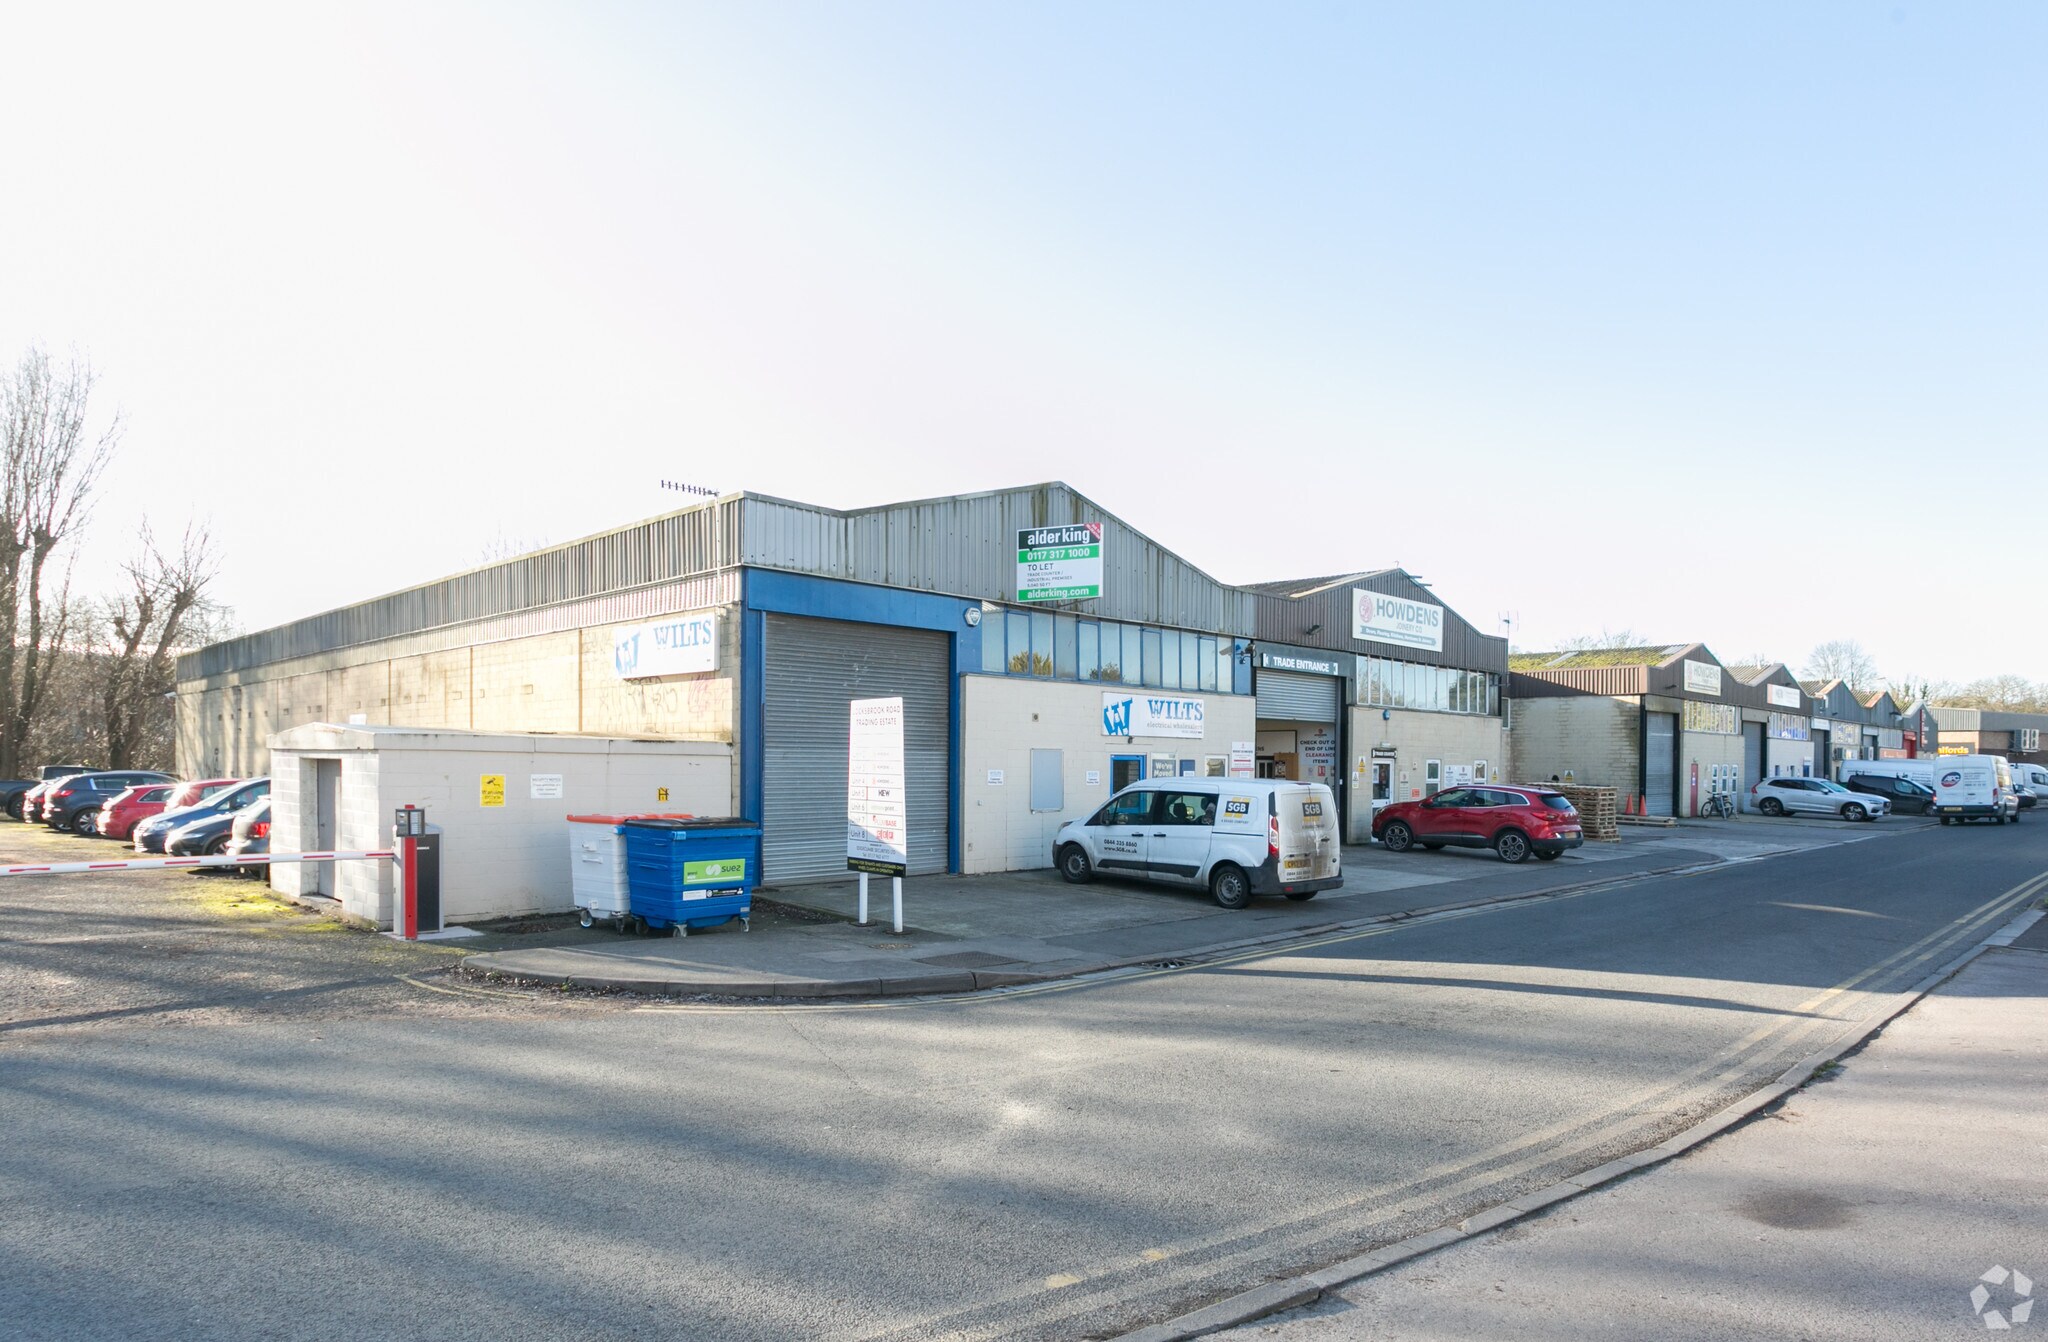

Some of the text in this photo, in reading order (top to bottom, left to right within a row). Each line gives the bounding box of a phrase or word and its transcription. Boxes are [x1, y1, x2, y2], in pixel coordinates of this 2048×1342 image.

[1027, 530, 1060, 545] alder
[1062, 527, 1090, 544] king
[1027, 548, 1090, 560] 0117 317 1000
[1027, 588, 1089, 598] alderking.com
[1376, 599, 1438, 627] HOWDENS
[653, 619, 712, 650] WILTS
[1273, 656, 1329, 672] TRADE ENTRANCE
[853, 704, 901, 715] OCKSBROOK ROAD
[1147, 699, 1203, 721] WILTS
[880, 717, 897, 726] ESTATE
[1228, 803, 1246, 812] SGB
[1305, 804, 1320, 814] SGB
[721, 864, 741, 873] suez
